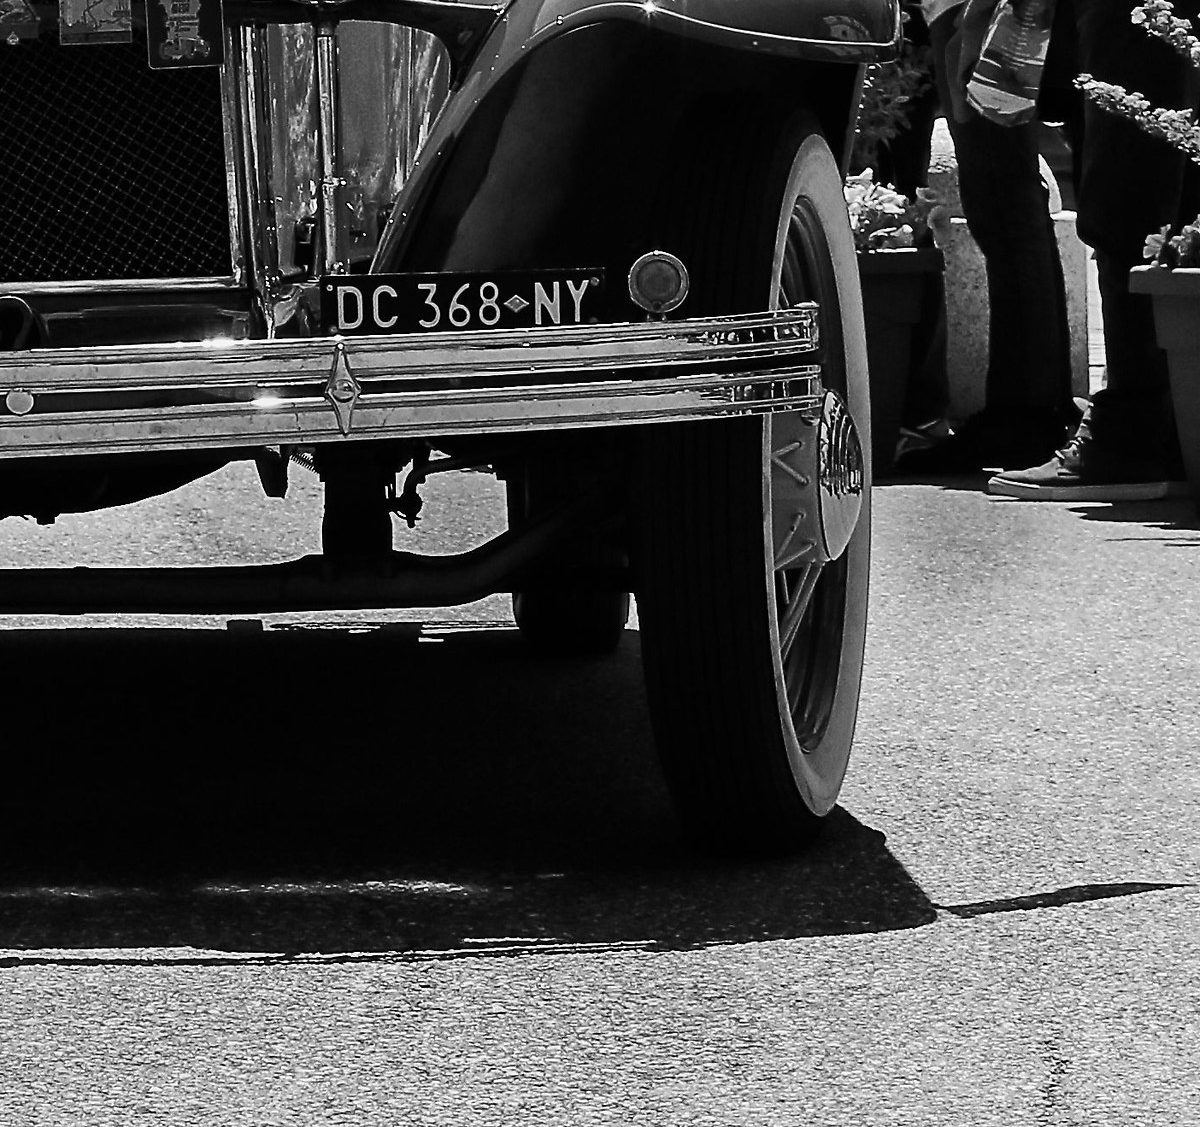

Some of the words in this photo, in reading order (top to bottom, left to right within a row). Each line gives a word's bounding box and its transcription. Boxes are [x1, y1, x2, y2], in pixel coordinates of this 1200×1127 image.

[337, 284, 399, 330] DC
[417, 281, 501, 328] 368
[534, 279, 590, 325] NY
